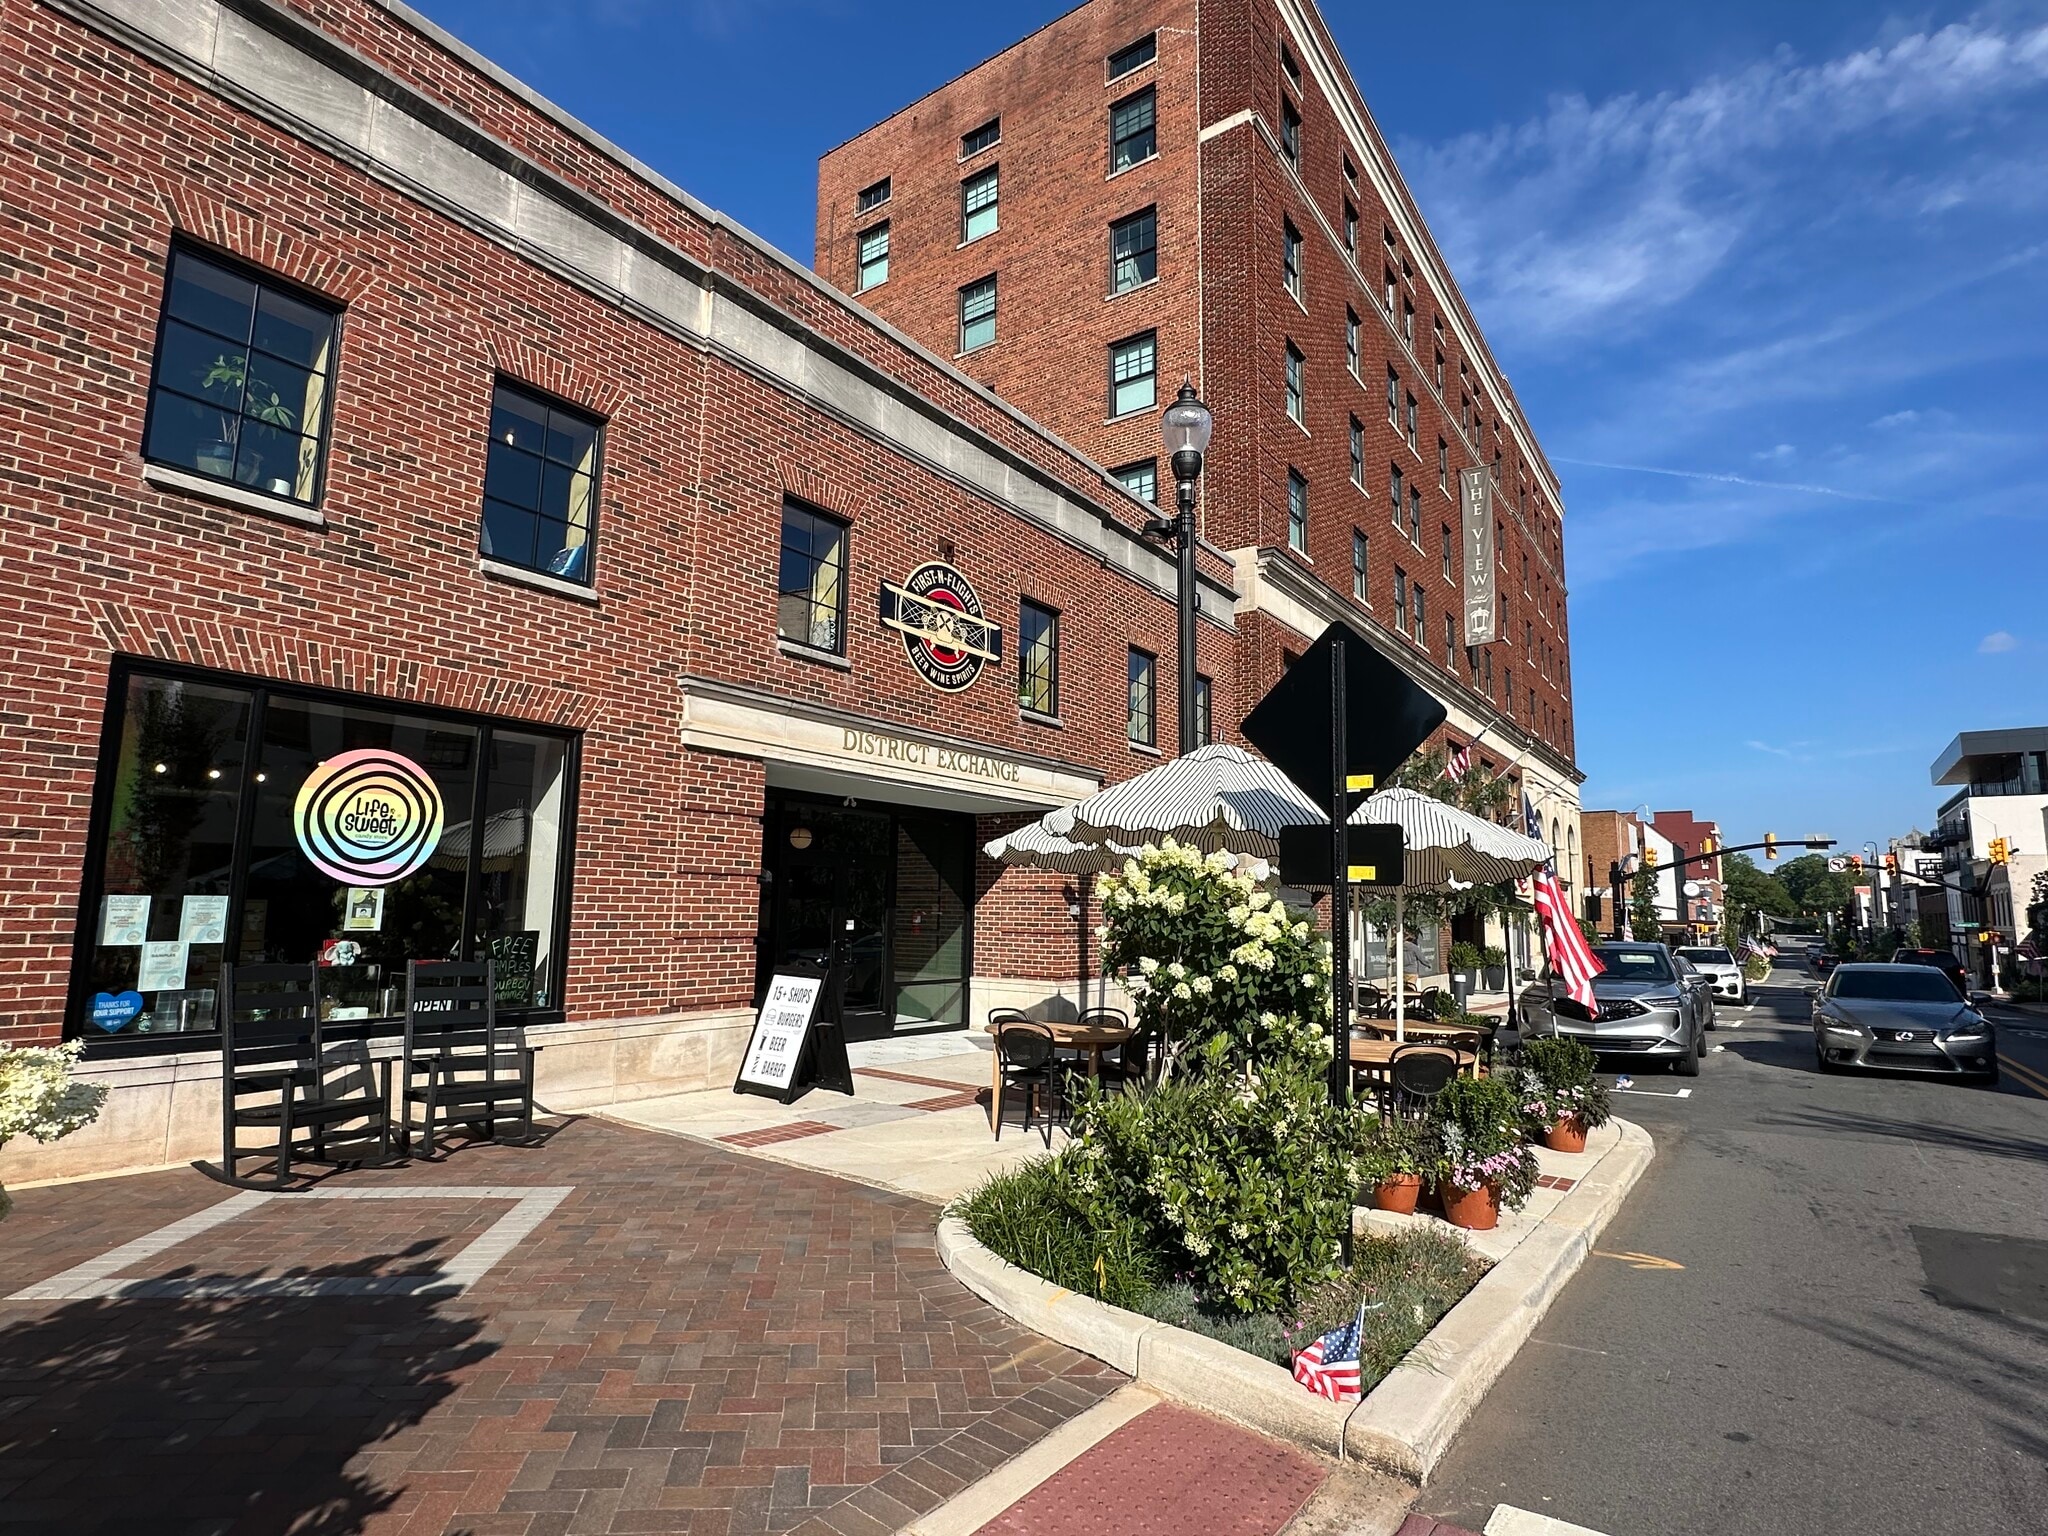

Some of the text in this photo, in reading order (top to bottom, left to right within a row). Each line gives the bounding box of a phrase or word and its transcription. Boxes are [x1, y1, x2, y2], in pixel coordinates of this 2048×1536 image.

[1470, 472, 1483, 516] THE
[1471, 527, 1488, 587] VIEW
[911, 645, 976, 685] BEER WINE SPIRITS
[842, 728, 1020, 782] DISTRICT EXCHANGE
[492, 936, 533, 955] FREE
[494, 960, 531, 973] AMPLES
[494, 978, 531, 991] OURBON
[495, 990, 526, 1002] ARAMEL
[773, 986, 813, 1004] 15+ SHOPS
[98, 999, 131, 1009] THANKS FOR
[109, 1007, 135, 1016] SUPPORT
[413, 1000, 452, 1012] OPEN
[777, 1011, 805, 1029] BURGERS
[769, 1036, 788, 1052] BEER
[761, 1061, 787, 1078] BARBER
